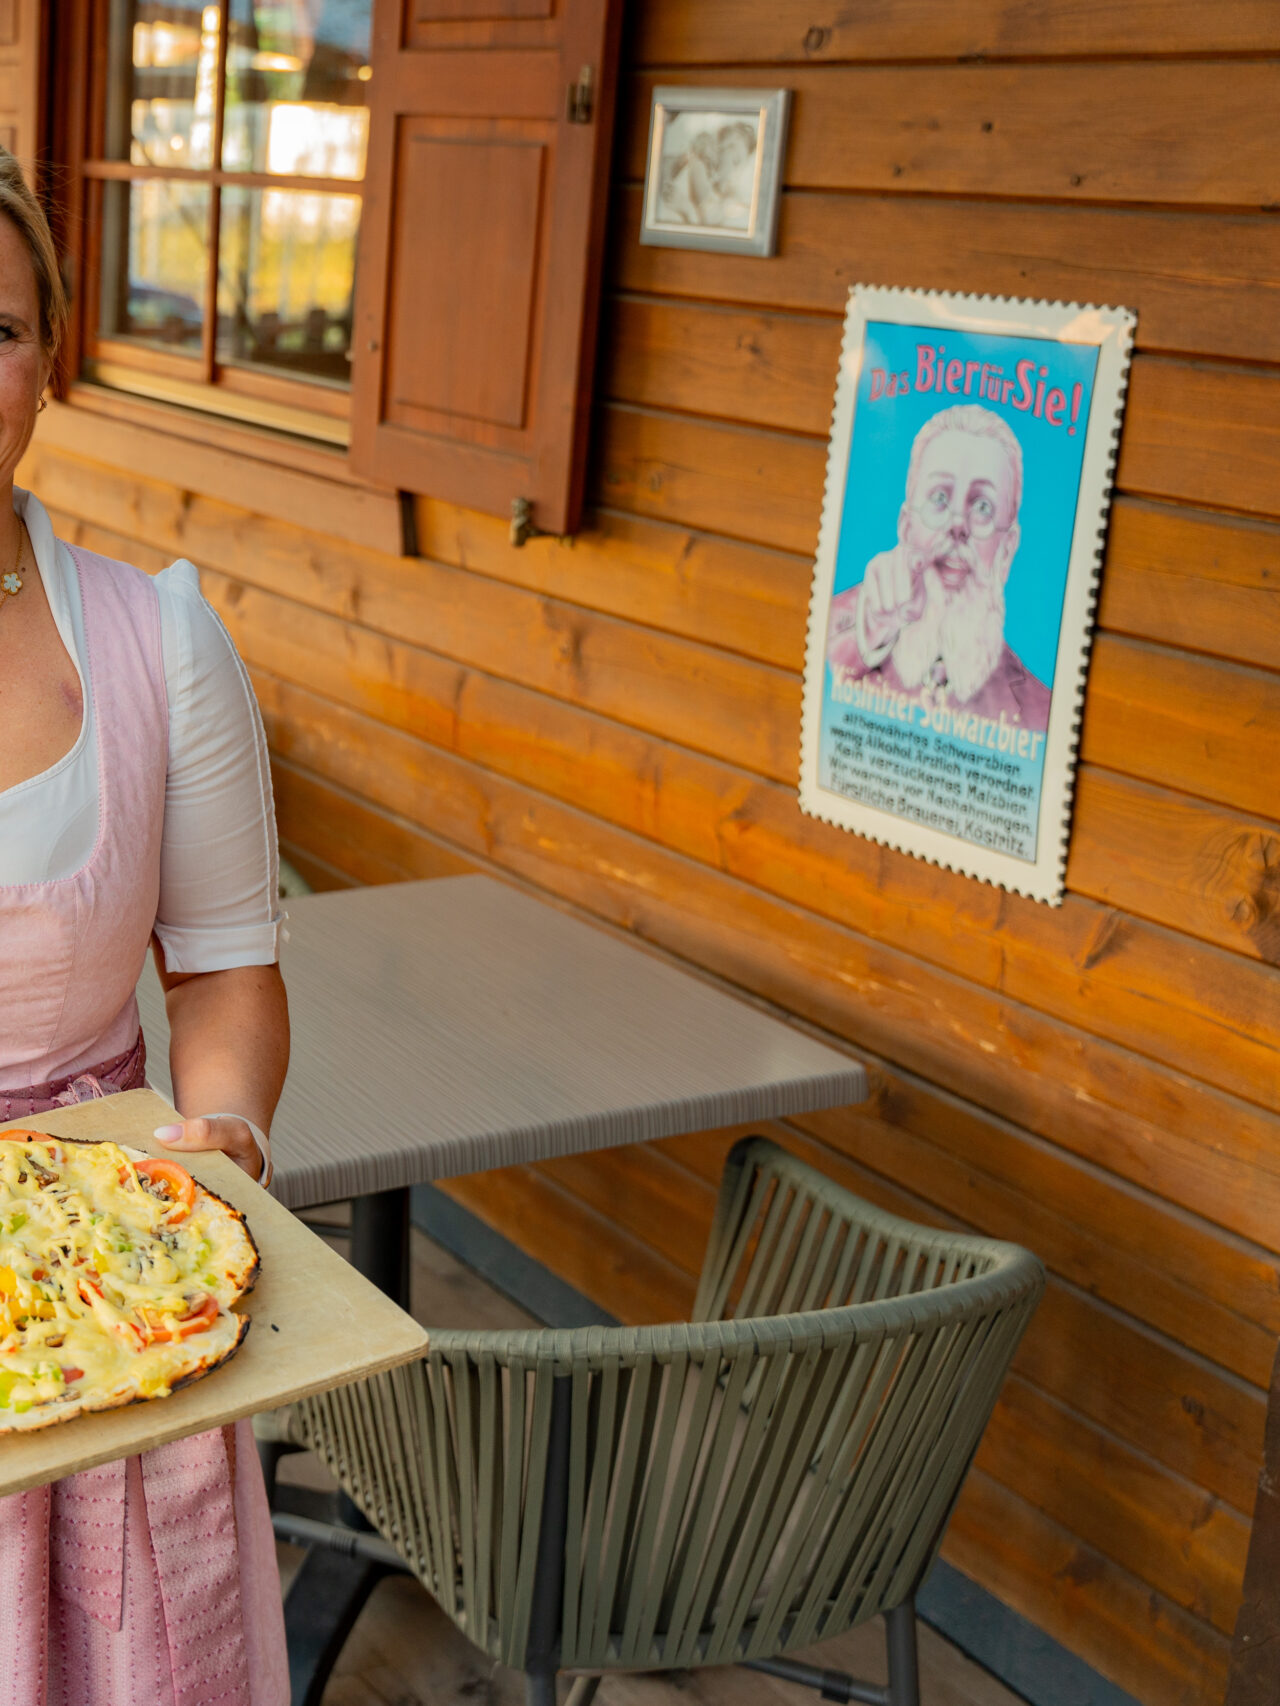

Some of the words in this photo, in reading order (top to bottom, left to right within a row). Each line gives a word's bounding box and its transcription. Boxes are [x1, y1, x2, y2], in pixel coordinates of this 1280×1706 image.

[868, 369, 911, 402] Das
[914, 344, 980, 395] Bier
[978, 361, 1015, 405] für
[1011, 359, 1083, 436] Sie!
[830, 727, 863, 748] wenig
[842, 713, 929, 747] altbewährtes
[919, 687, 1044, 761] Schwarzbier
[834, 741, 864, 762] Kein
[869, 755, 962, 796] verzuckertes
[851, 766, 900, 788] warnen
[903, 782, 923, 797] vor
